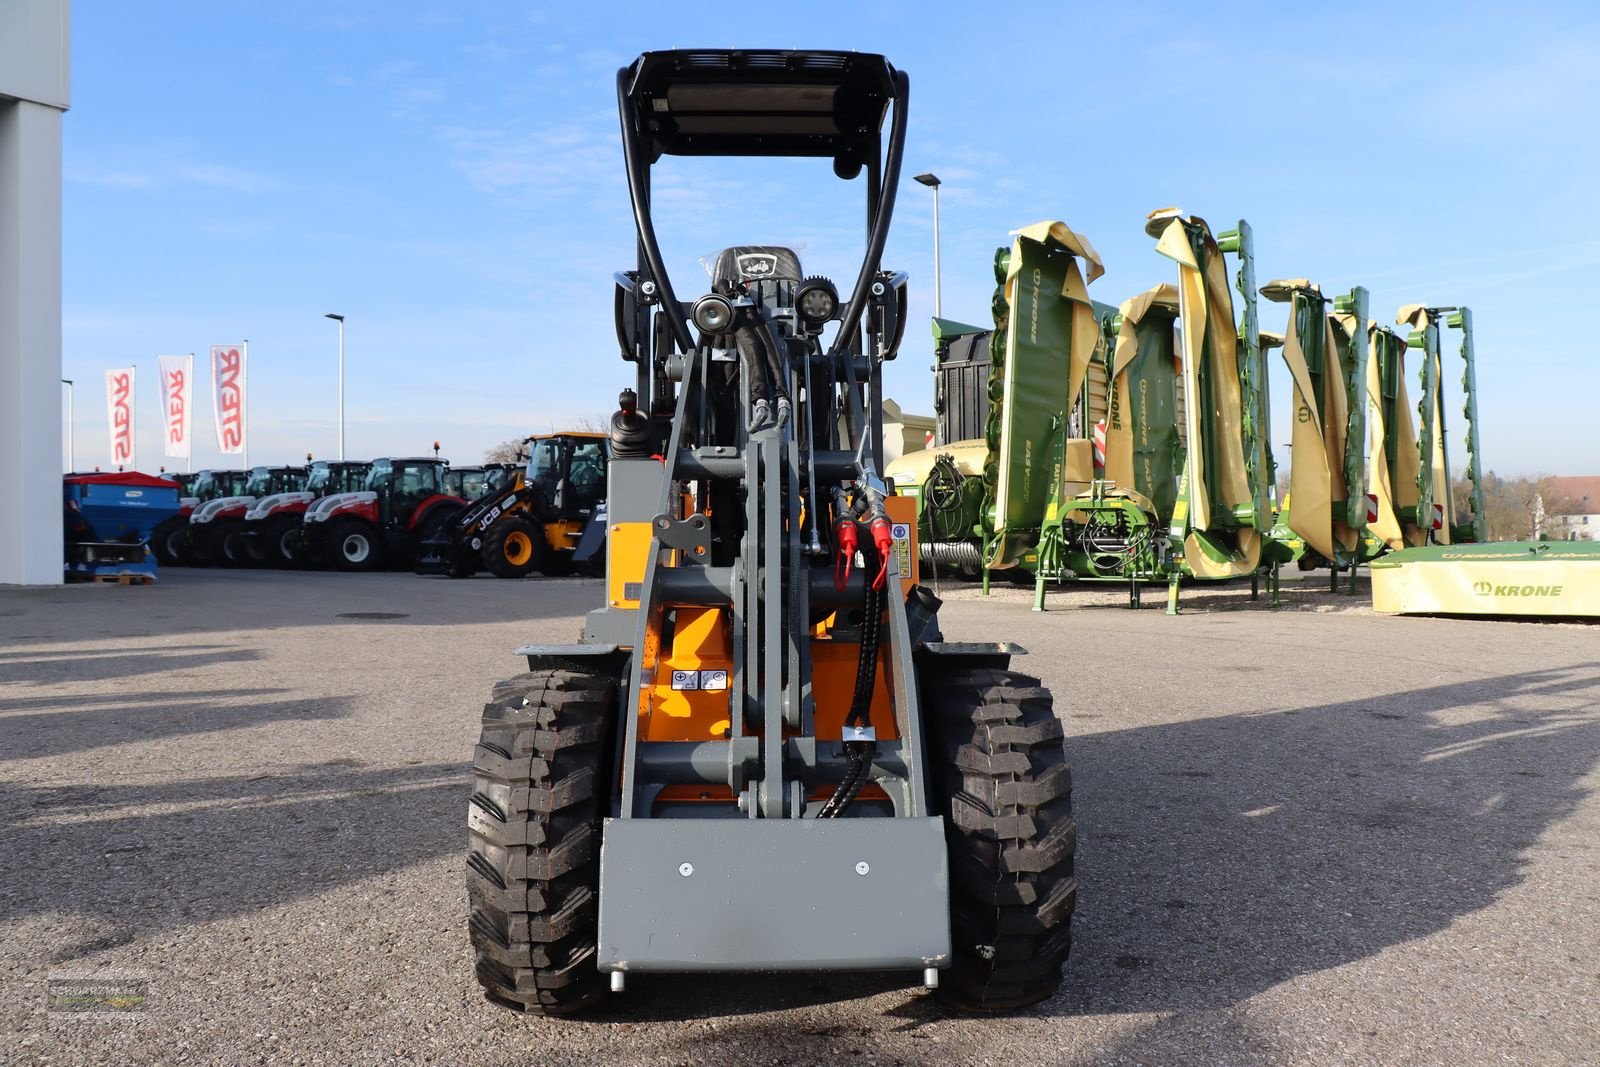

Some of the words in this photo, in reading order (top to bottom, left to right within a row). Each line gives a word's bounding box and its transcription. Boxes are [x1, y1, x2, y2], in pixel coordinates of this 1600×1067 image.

[1030, 286, 1040, 345] KRONE
[479, 506, 501, 531] JCB
[1494, 585, 1563, 597] KRONE
